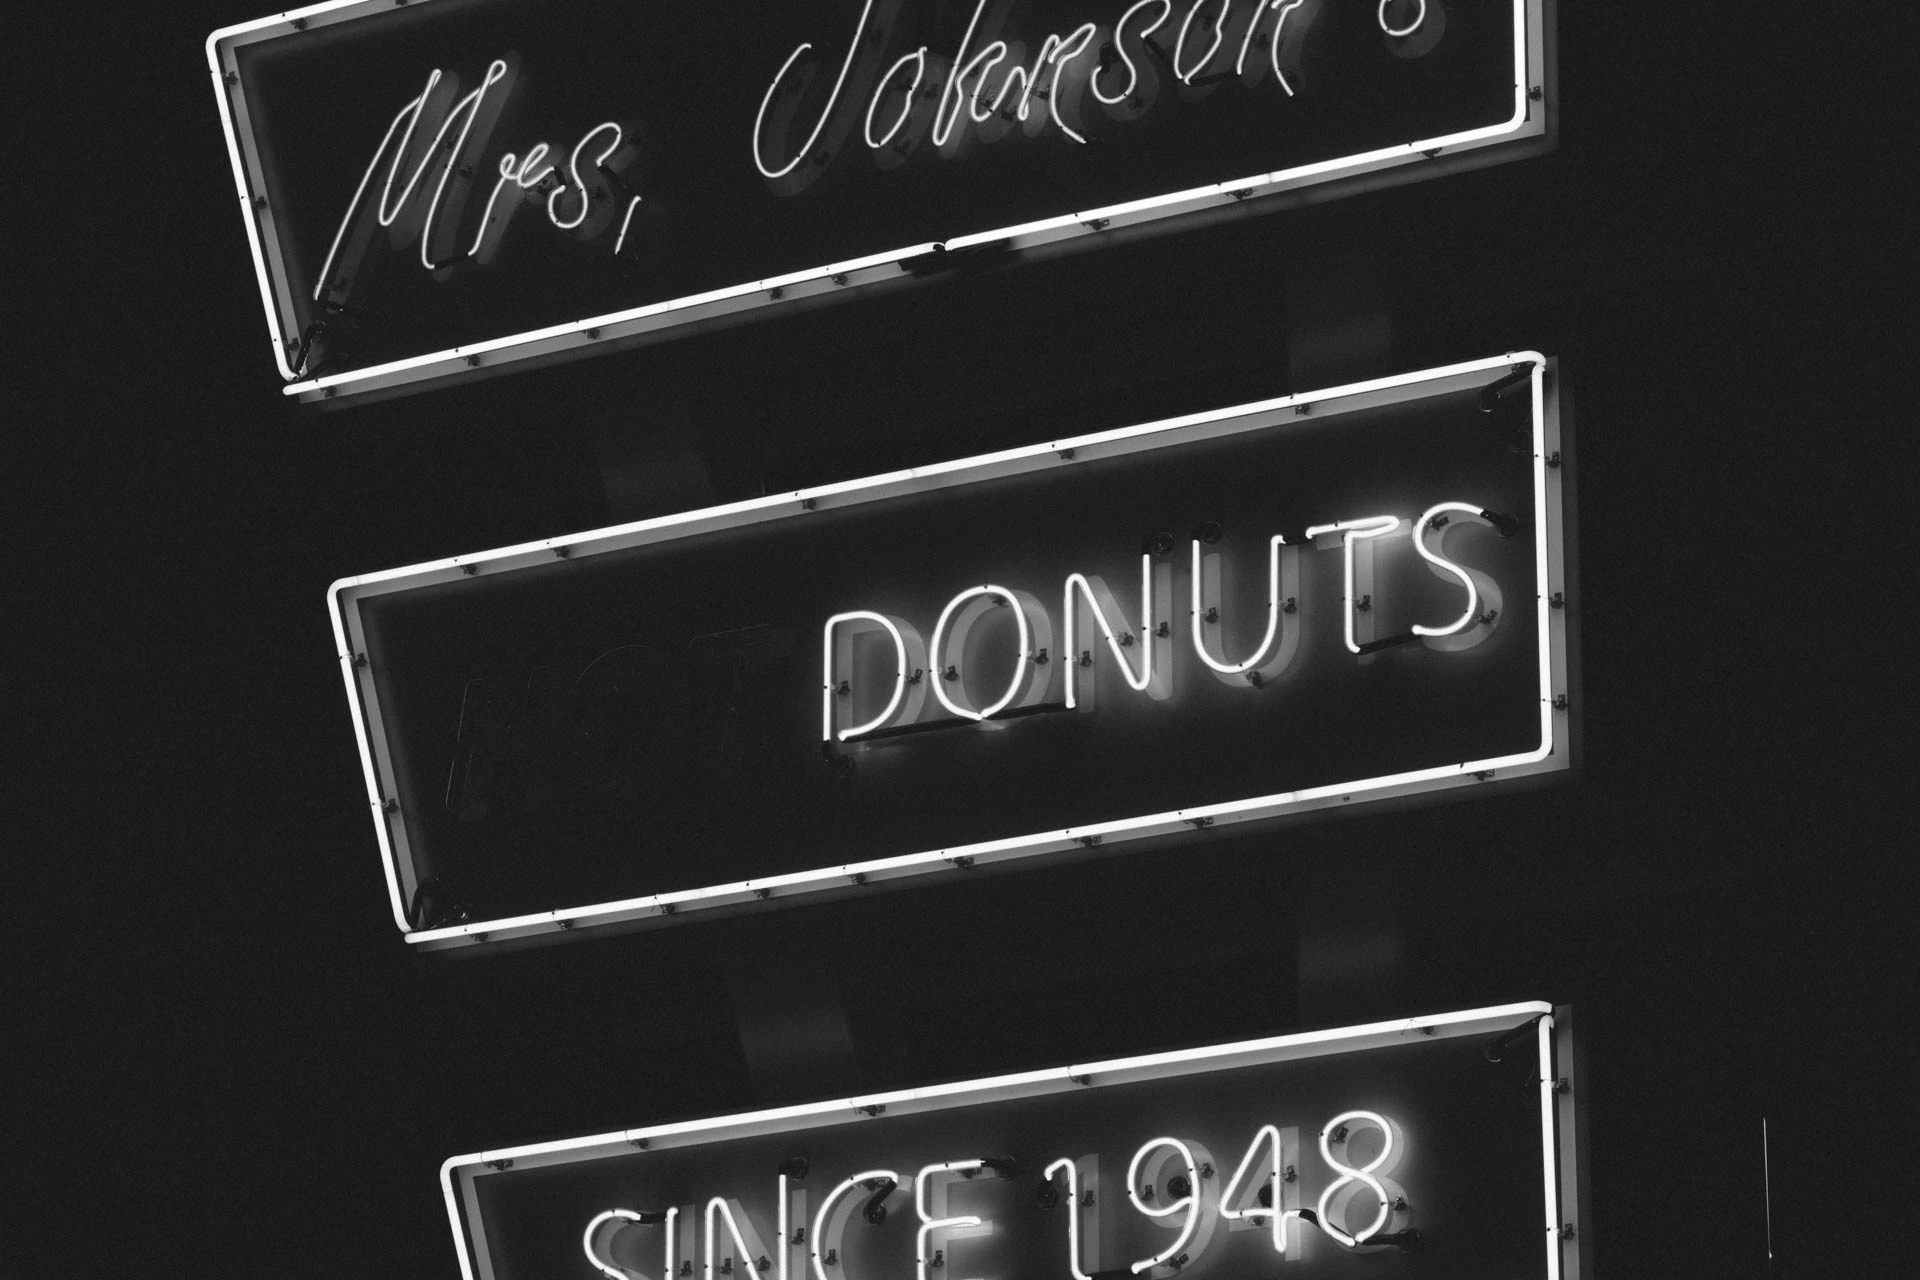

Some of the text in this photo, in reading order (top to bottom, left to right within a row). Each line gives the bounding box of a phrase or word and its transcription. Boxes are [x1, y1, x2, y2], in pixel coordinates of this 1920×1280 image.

[822, 501, 1490, 742] DONUTS
[583, 1109, 1395, 1280] SINCE 1948
